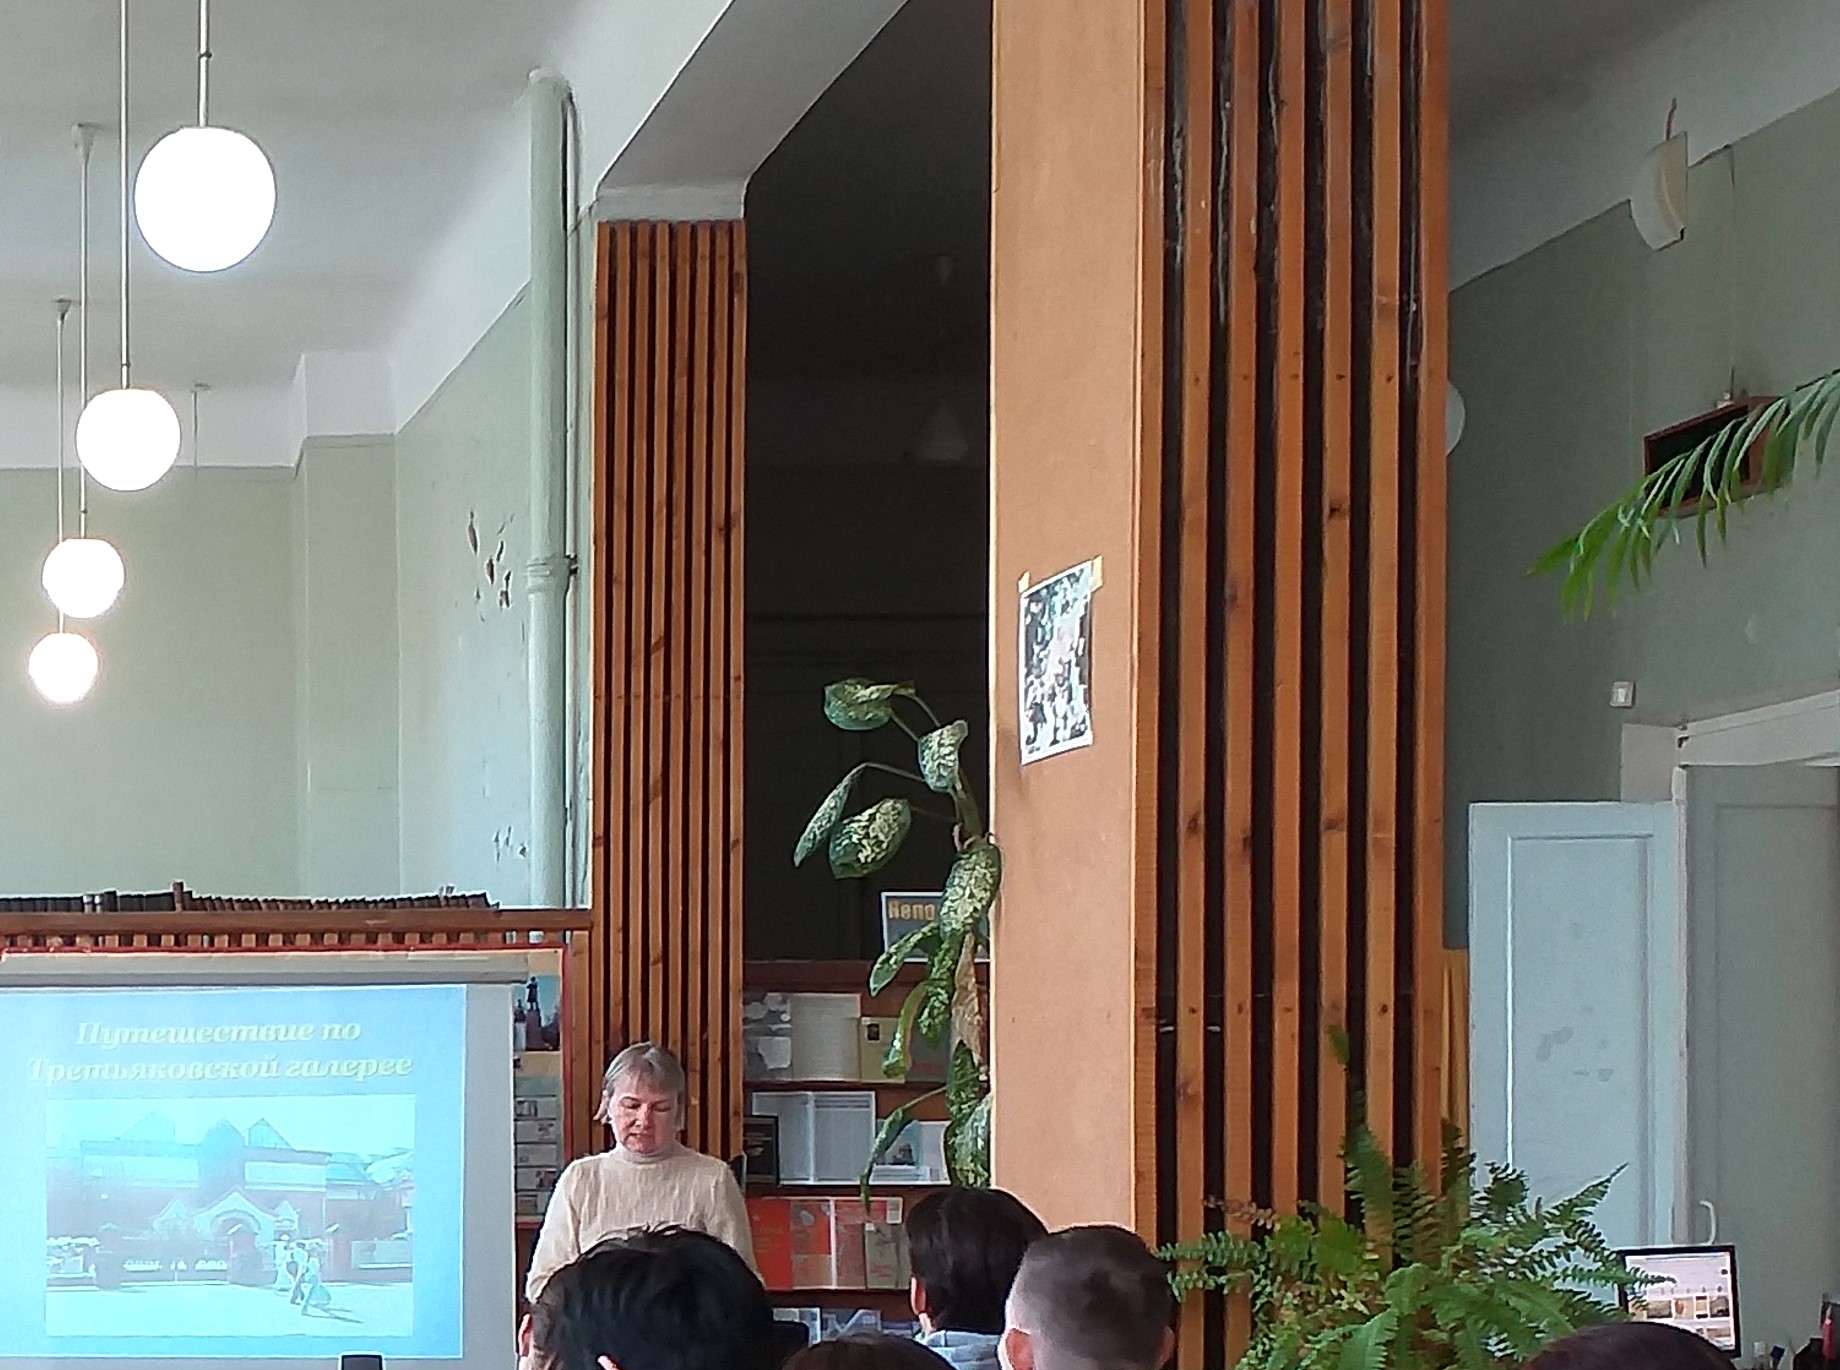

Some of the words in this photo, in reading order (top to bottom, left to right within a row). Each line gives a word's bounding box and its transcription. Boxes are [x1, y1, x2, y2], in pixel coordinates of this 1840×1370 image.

[888, 901, 937, 920] Непо
[77, 1022, 314, 1049] Путешествие
[321, 1022, 361, 1041] по
[29, 1054, 279, 1088] Третьяковской
[285, 1057, 413, 1083] галерее
